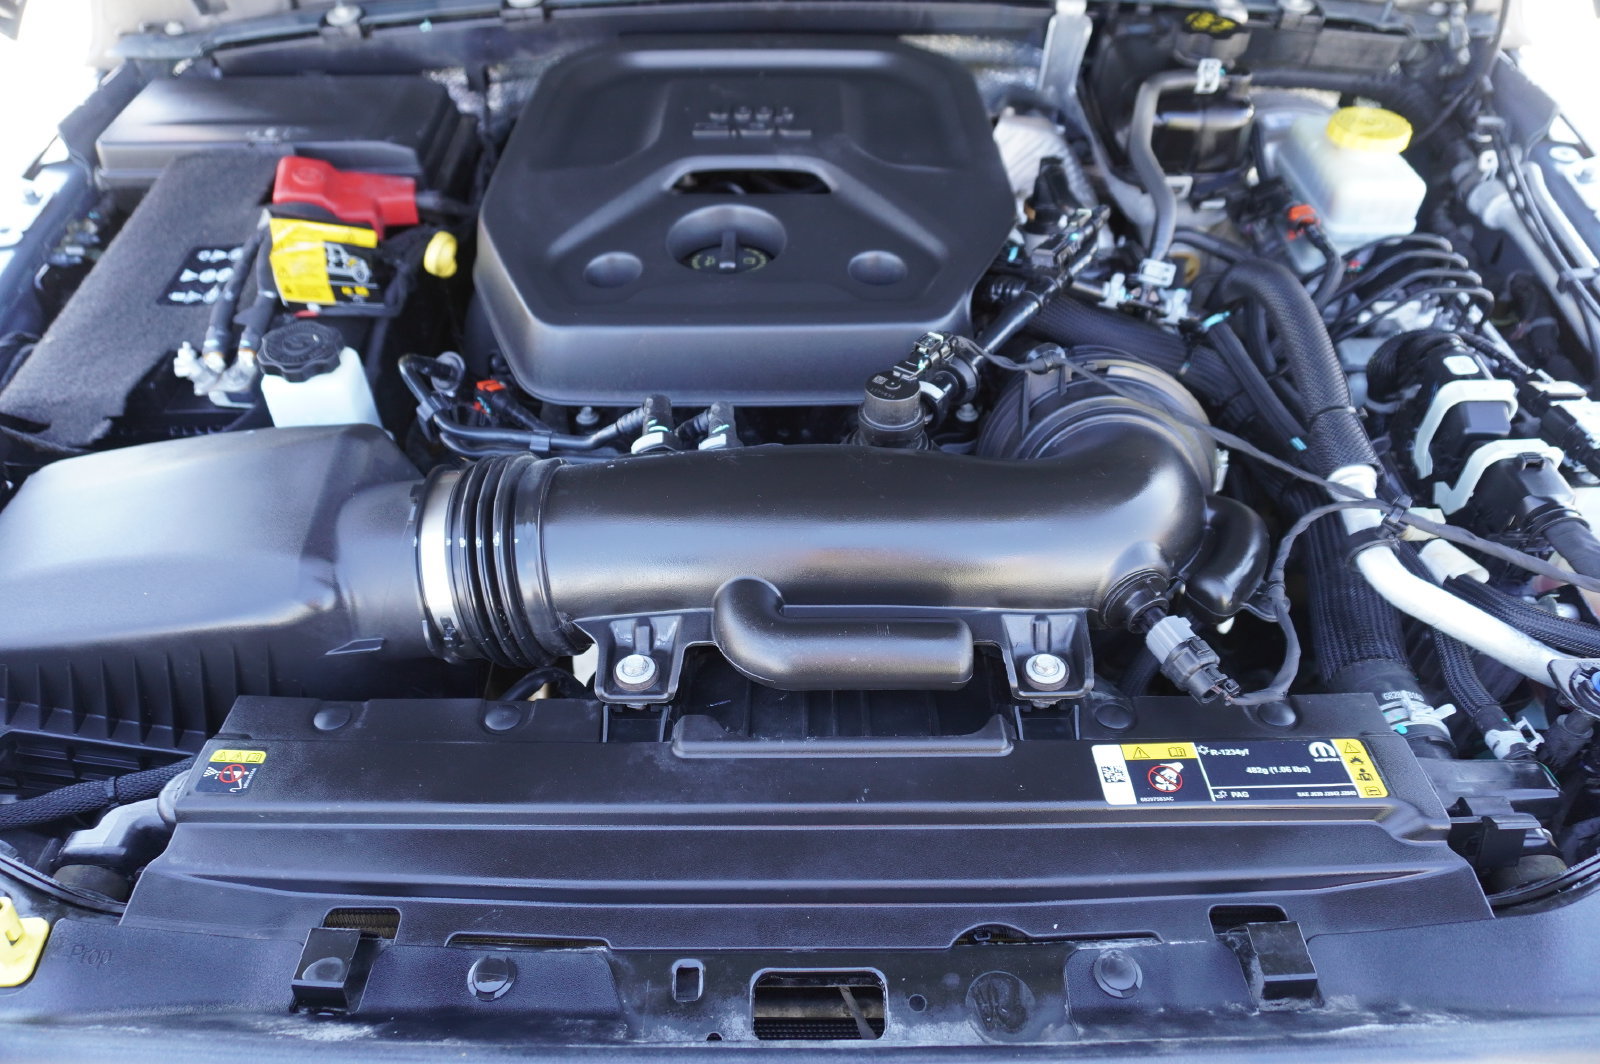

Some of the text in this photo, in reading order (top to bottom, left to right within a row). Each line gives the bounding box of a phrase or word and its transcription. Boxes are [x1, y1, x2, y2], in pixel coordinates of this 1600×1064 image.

[1210, 748, 1249, 756] R-1234yf
[1246, 766, 1269, 775] 482g
[70, 944, 112, 968] Prop
